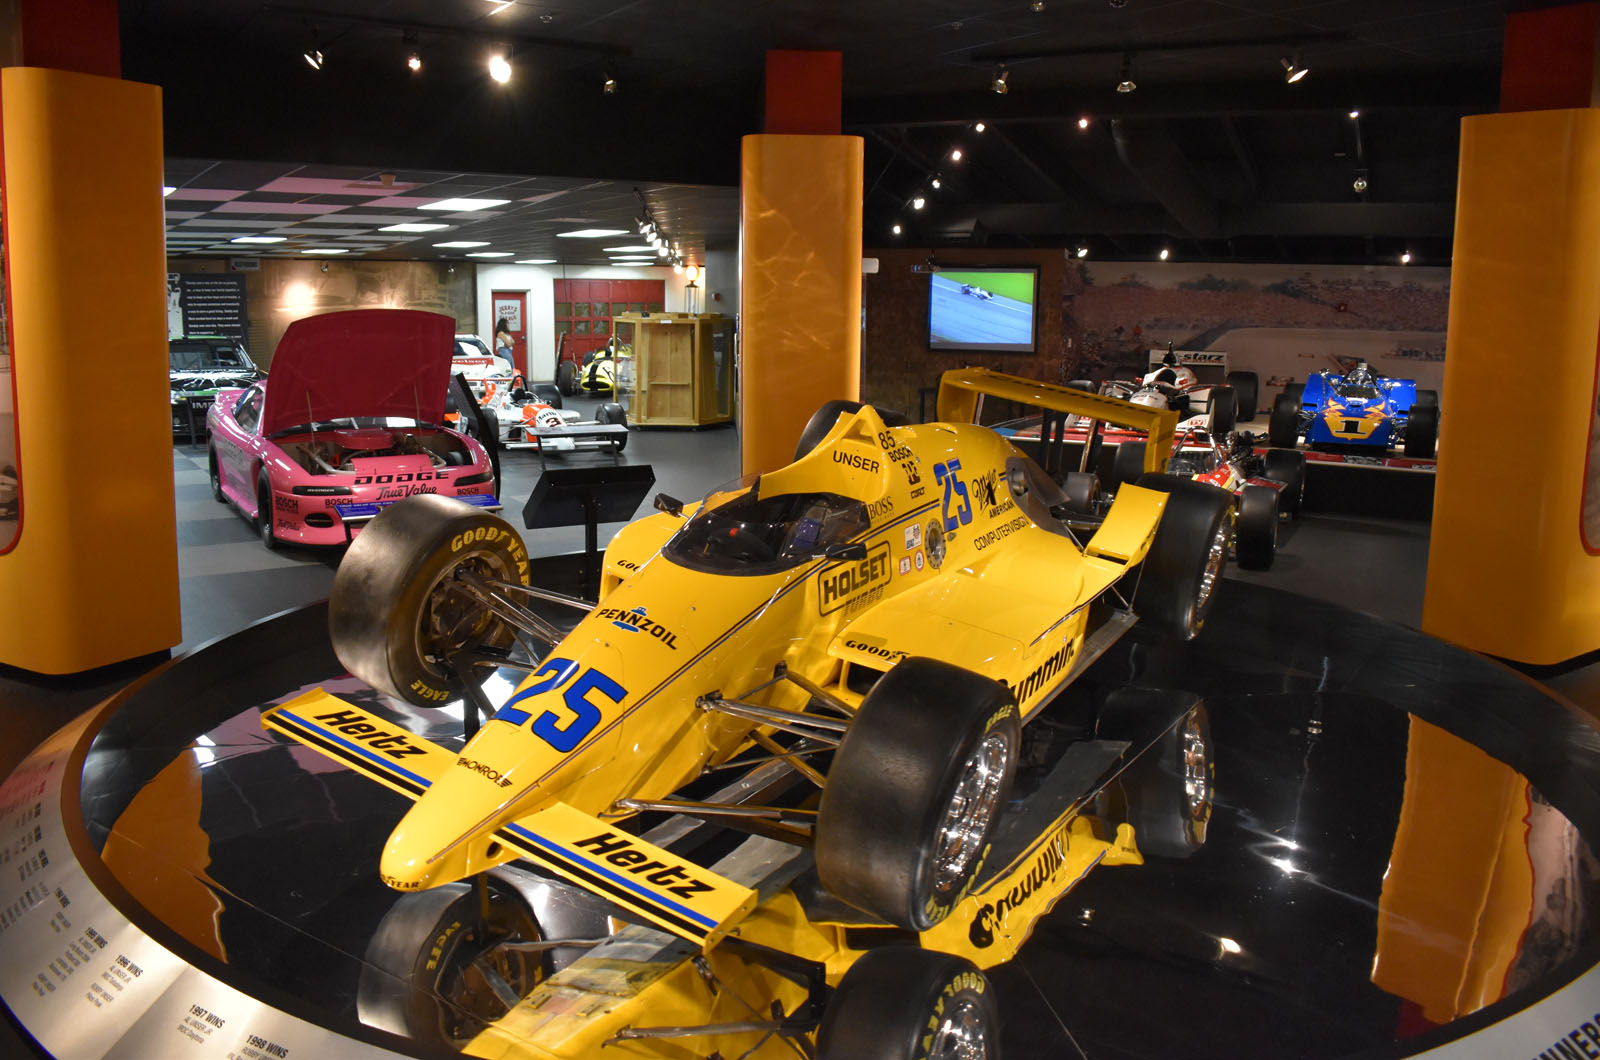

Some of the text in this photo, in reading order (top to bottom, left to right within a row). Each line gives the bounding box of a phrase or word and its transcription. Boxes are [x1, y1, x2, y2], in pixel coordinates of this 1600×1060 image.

[1183, 353, 1225, 361] starz
[545, 417, 562, 427] 3
[1333, 420, 1368, 435] 1
[878, 430, 896, 450] 85
[832, 450, 880, 474] UNSER
[888, 446, 914, 462] BOSCH
[354, 471, 449, 485] DODGE
[457, 487, 479, 496] BOSCH
[933, 457, 973, 534] 25
[868, 496, 894, 519] BOSS
[989, 500, 1015, 519] AMERICAN
[974, 513, 1030, 551] COMPUTERVISION
[823, 551, 888, 605] HOLSET
[595, 608, 677, 650] PENNZOIL
[410, 679, 450, 701] EAGLE
[493, 657, 629, 753] 25
[313, 710, 429, 759] Hertz
[457, 757, 512, 788] MONROE
[571, 832, 717, 900] Hertz
[188, 1004, 226, 1030] 1997 WINS
[246, 1034, 268, 1050] 1998
[265, 1041, 289, 1059] WINS
